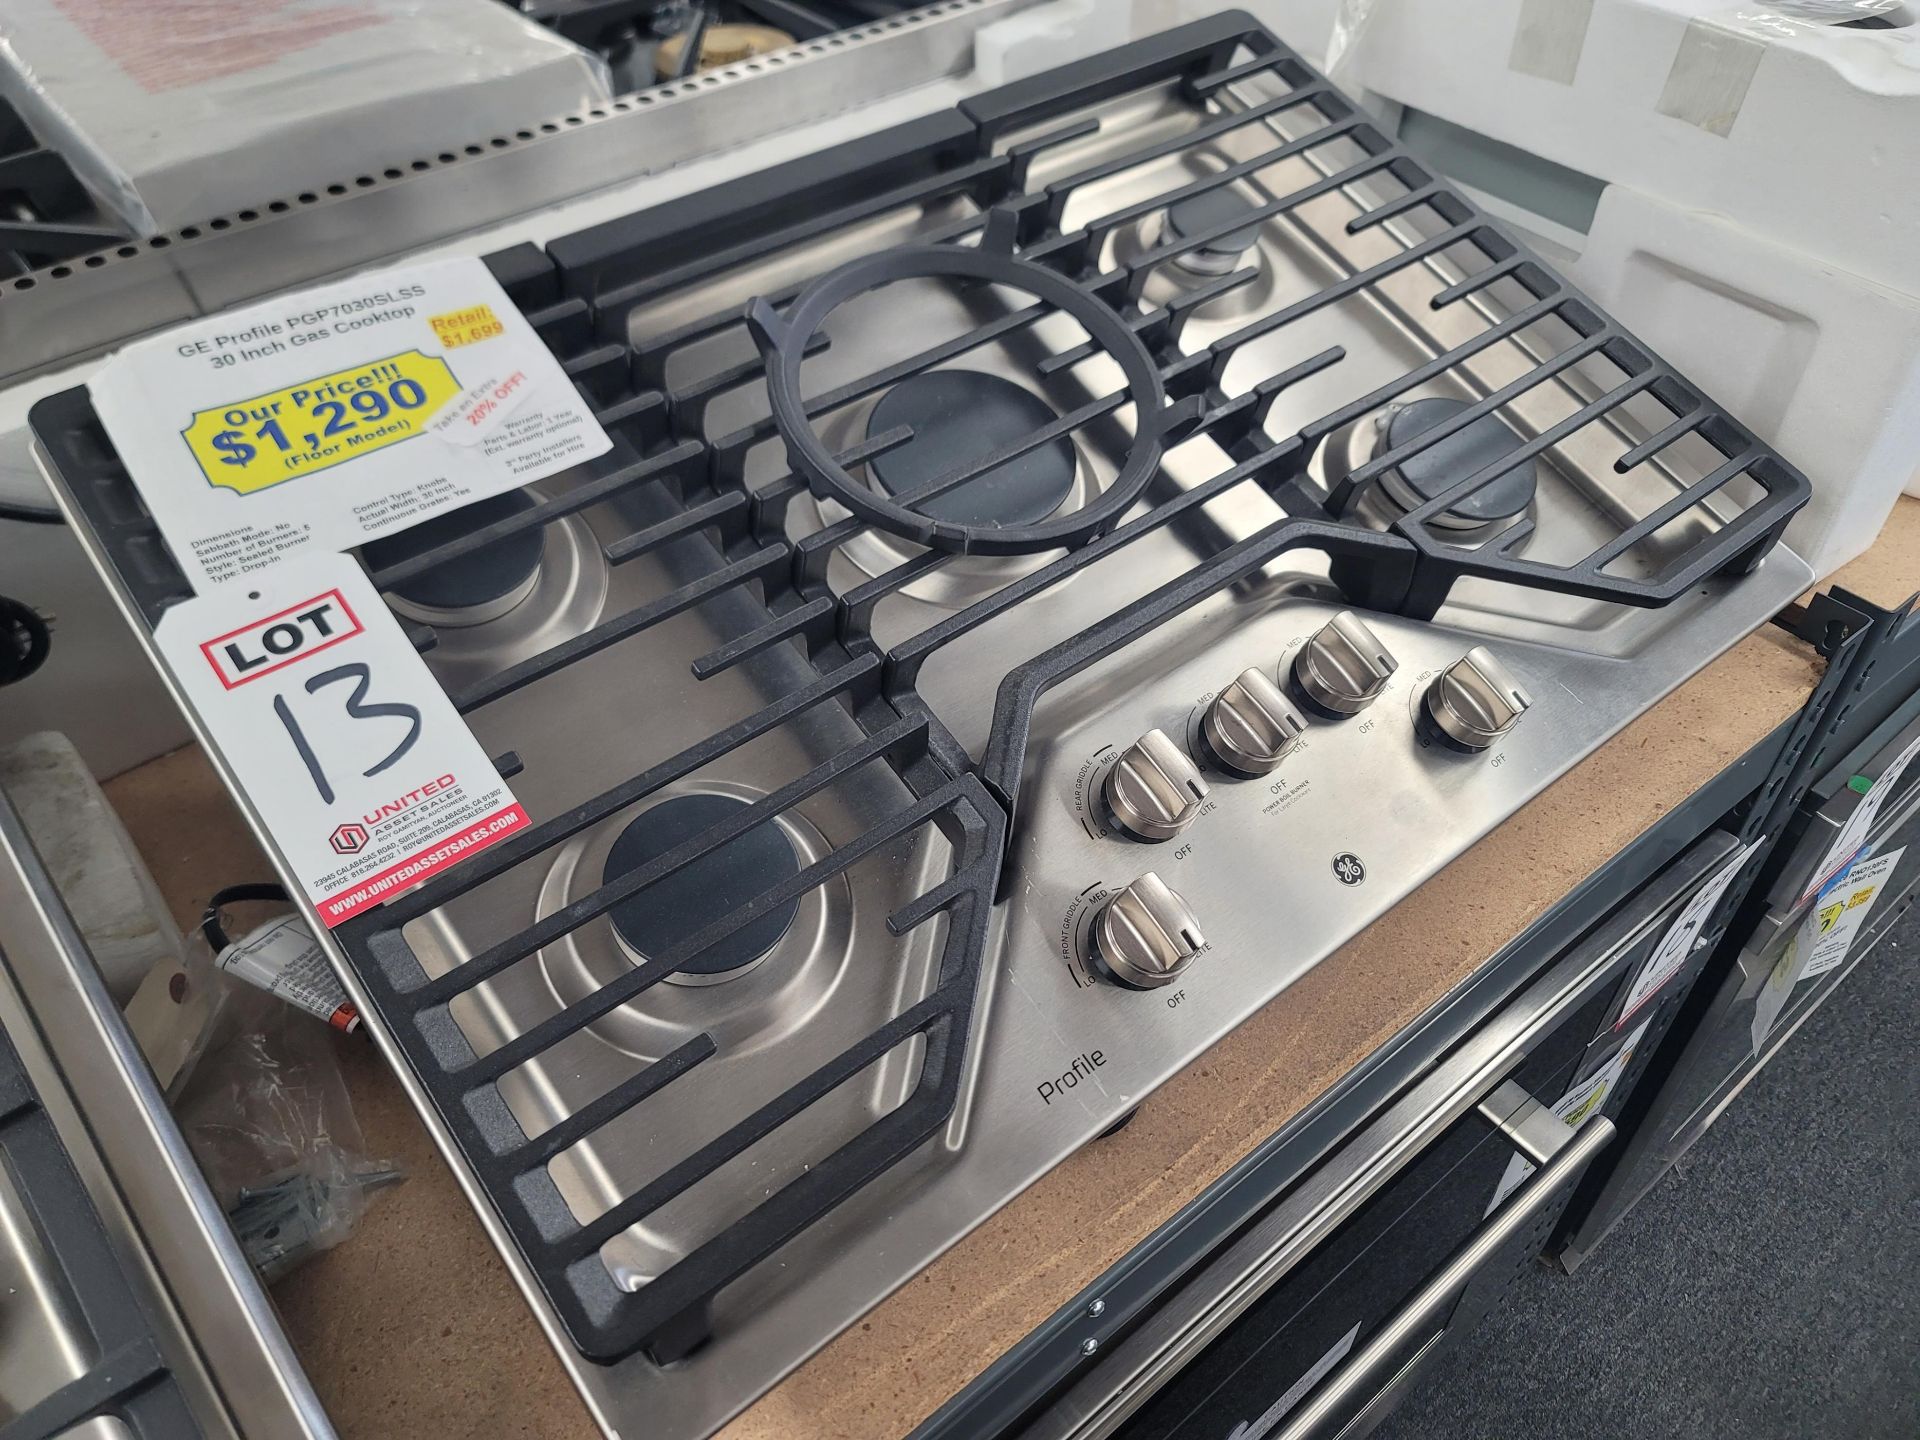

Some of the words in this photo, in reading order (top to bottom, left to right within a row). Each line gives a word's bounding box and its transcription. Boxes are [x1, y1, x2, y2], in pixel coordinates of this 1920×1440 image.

[178, 341, 212, 358] GE
[216, 323, 282, 348] Profile
[287, 285, 426, 329] PGP7030SLSS
[431, 307, 493, 331] Retail:
[210, 354, 236, 370] 30
[241, 340, 286, 362] Inch
[290, 329, 330, 346] Gas
[334, 306, 416, 334] Cooktop
[224, 401, 283, 426] Our
[291, 363, 403, 408] Price!!!
[467, 399, 497, 426] 20%
[494, 370, 527, 400] OFF!
[212, 379, 427, 469] $1,290
[434, 410, 461, 432] Take
[504, 412, 543, 430] Warranty
[285, 443, 341, 470] (Floor
[346, 419, 411, 446] Model)
[353, 496, 388, 514] Control
[389, 488, 416, 501] Type:
[416, 477, 448, 492] Knobs
[359, 508, 389, 522] Actual
[390, 496, 420, 511] Width:
[422, 490, 434, 500] 30
[434, 483, 456, 494] Inch
[364, 508, 418, 532] Continuous
[419, 494, 452, 511] Grates:
[454, 487, 472, 498] Yes
[191, 525, 254, 549] Dimensions
[196, 538, 240, 557] Sabbath
[241, 530, 274, 542] Mode:
[275, 522, 290, 532] No
[200, 548, 242, 566] Number
[246, 543, 256, 552] of
[258, 528, 302, 548] Burners:
[304, 524, 311, 532] 5
[206, 560, 237, 574] Style:
[238, 547, 274, 564] Sealed
[275, 534, 311, 551] Burner
[210, 570, 240, 584] Type:
[224, 603, 334, 672] LOT
[1286, 637, 1302, 650] MED
[1416, 670, 1432, 682] MED
[1196, 692, 1214, 706] MED
[274, 662, 422, 804] 13
[1358, 719, 1376, 734] OFF
[1077, 759, 1093, 790] GRIDDLE
[1100, 752, 1119, 766] MED
[1490, 752, 1506, 768] OFF
[362, 773, 456, 824] UNITED
[1262, 800, 1281, 814] POWER
[1290, 779, 1310, 795] BURNER
[1270, 778, 1288, 795] OFF
[374, 812, 418, 836] ASSET
[420, 788, 463, 814] SALES
[378, 834, 393, 843] ROY
[428, 795, 468, 818] AUCTIONEER
[314, 875, 336, 888] 23945
[336, 852, 378, 876] CALABASAS
[378, 842, 399, 856] ROAD,
[399, 834, 418, 846] SUITE
[432, 804, 472, 828] CALABASAS,
[472, 796, 483, 806] CA
[324, 876, 349, 892] OFFICE
[403, 798, 500, 852] ROY@UNITEDASSETSALES.COM
[1096, 828, 1108, 840] LO
[1174, 843, 1194, 860] OFF
[328, 811, 519, 916] WWW.UNITEDASSETSALES.COM
[1868, 867, 1888, 878] Oven
[1063, 896, 1082, 930] GRIDDLE
[1088, 889, 1108, 906] MED
[1061, 934, 1070, 960] FRONT
[1084, 975, 1096, 988] LO
[1166, 989, 1187, 1009] OFF
[1036, 1050, 1107, 1105] Profile
